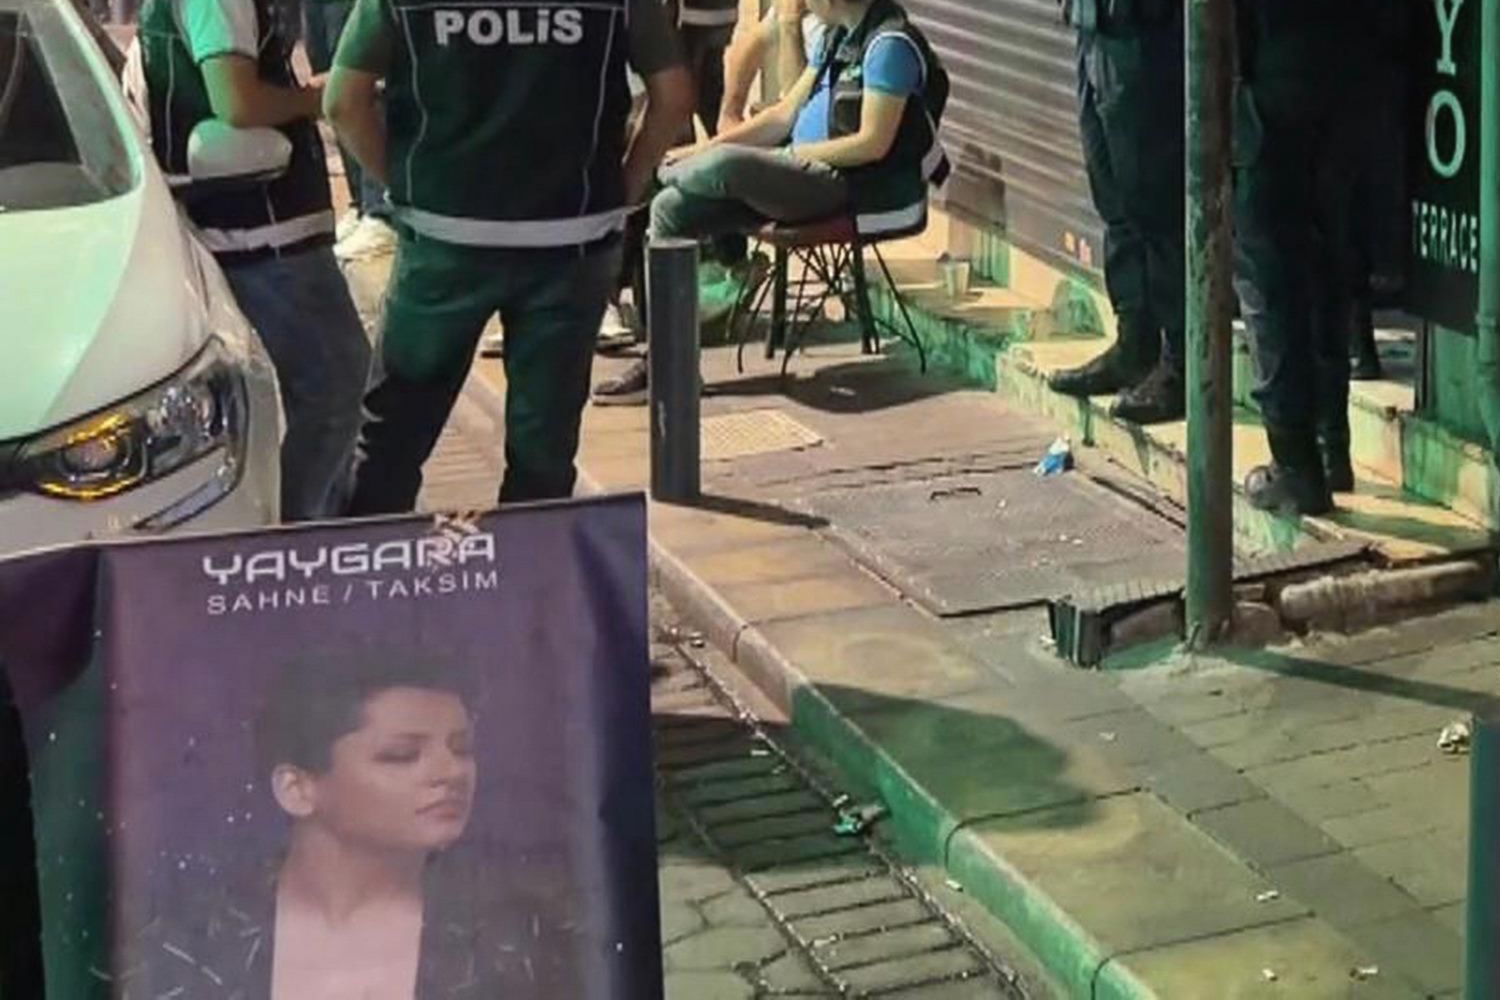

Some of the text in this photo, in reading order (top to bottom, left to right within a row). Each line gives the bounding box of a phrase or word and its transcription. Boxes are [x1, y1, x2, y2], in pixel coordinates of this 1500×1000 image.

[1411, 198, 1478, 274] TERRACE
[202, 533, 496, 586] YAYGARA
[206, 584, 331, 616] SAHNE
